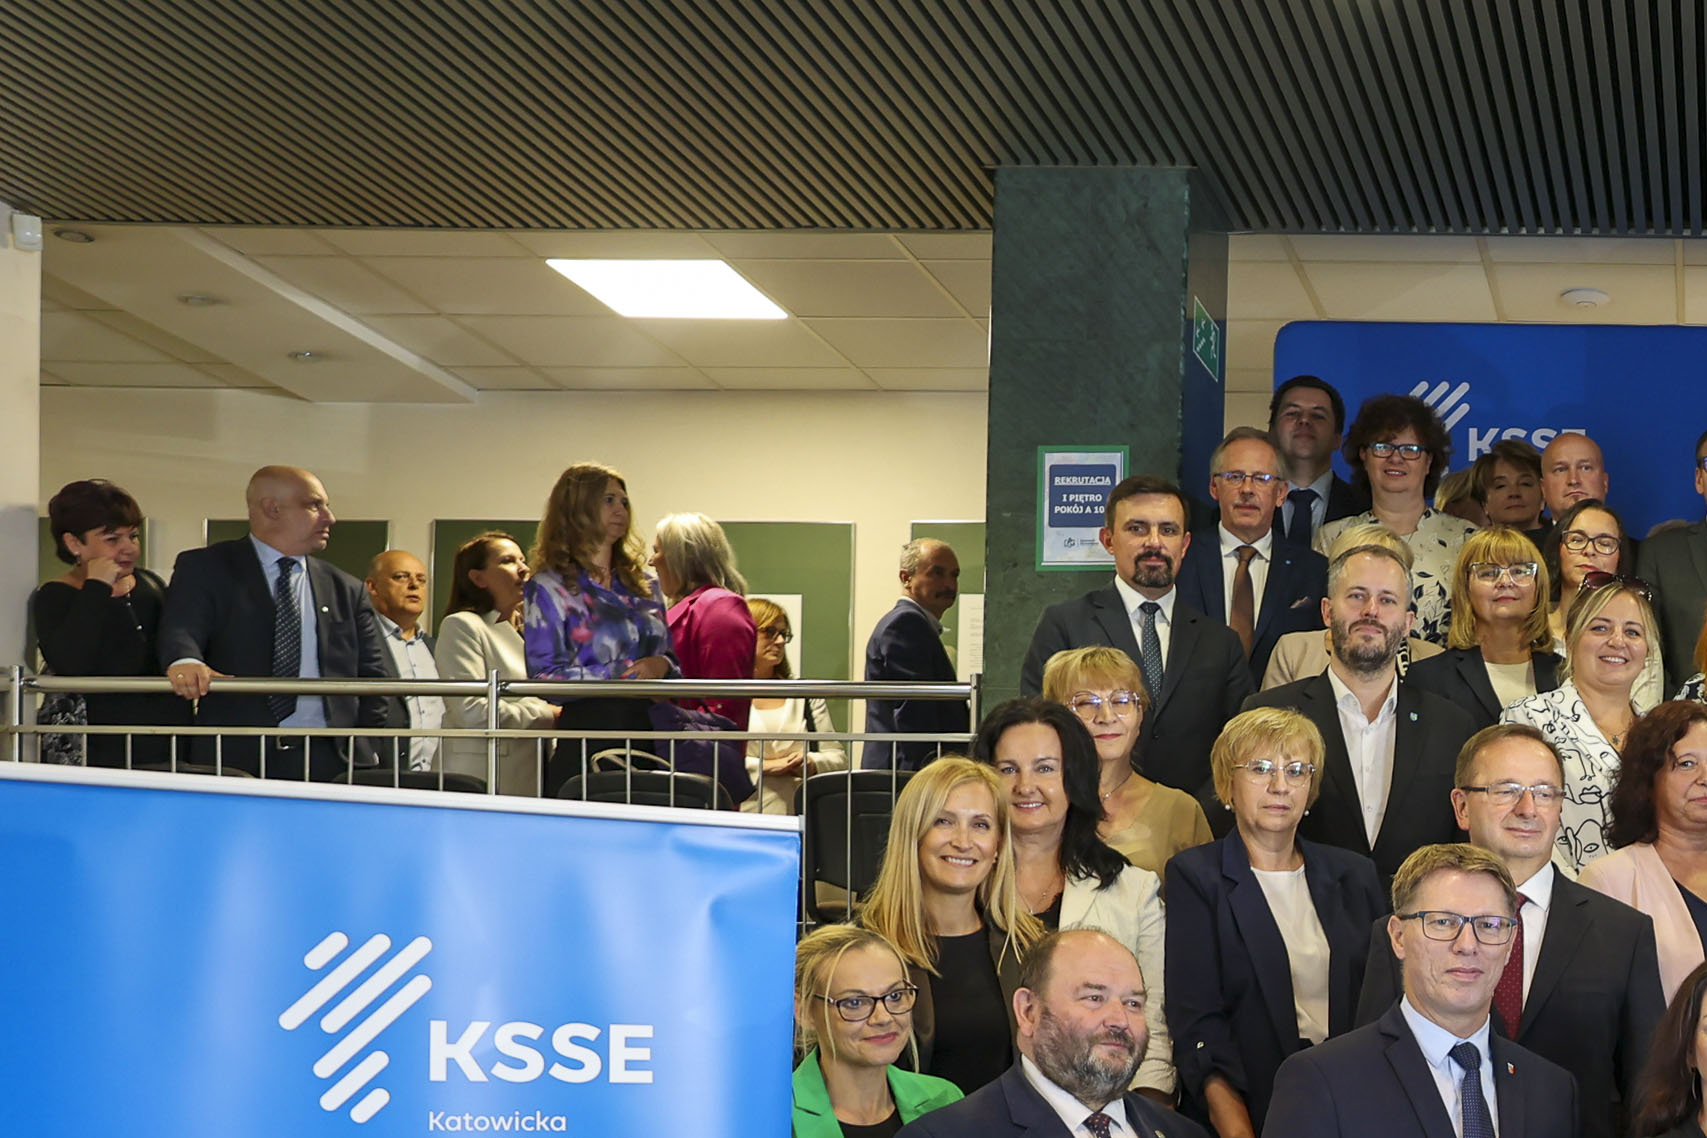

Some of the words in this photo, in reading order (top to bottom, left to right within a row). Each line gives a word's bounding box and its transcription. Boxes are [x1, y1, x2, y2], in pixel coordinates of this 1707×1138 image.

[1054, 476, 1112, 486] REKRUTACJA
[1062, 494, 1068, 502] I
[1069, 494, 1103, 504] PIĘTRO
[1054, 503, 1084, 514] POKÓJ
[1084, 505, 1093, 514] A
[1093, 505, 1106, 514] 10
[429, 1019, 654, 1084] KSSE
[428, 1110, 567, 1132] Katowicka
